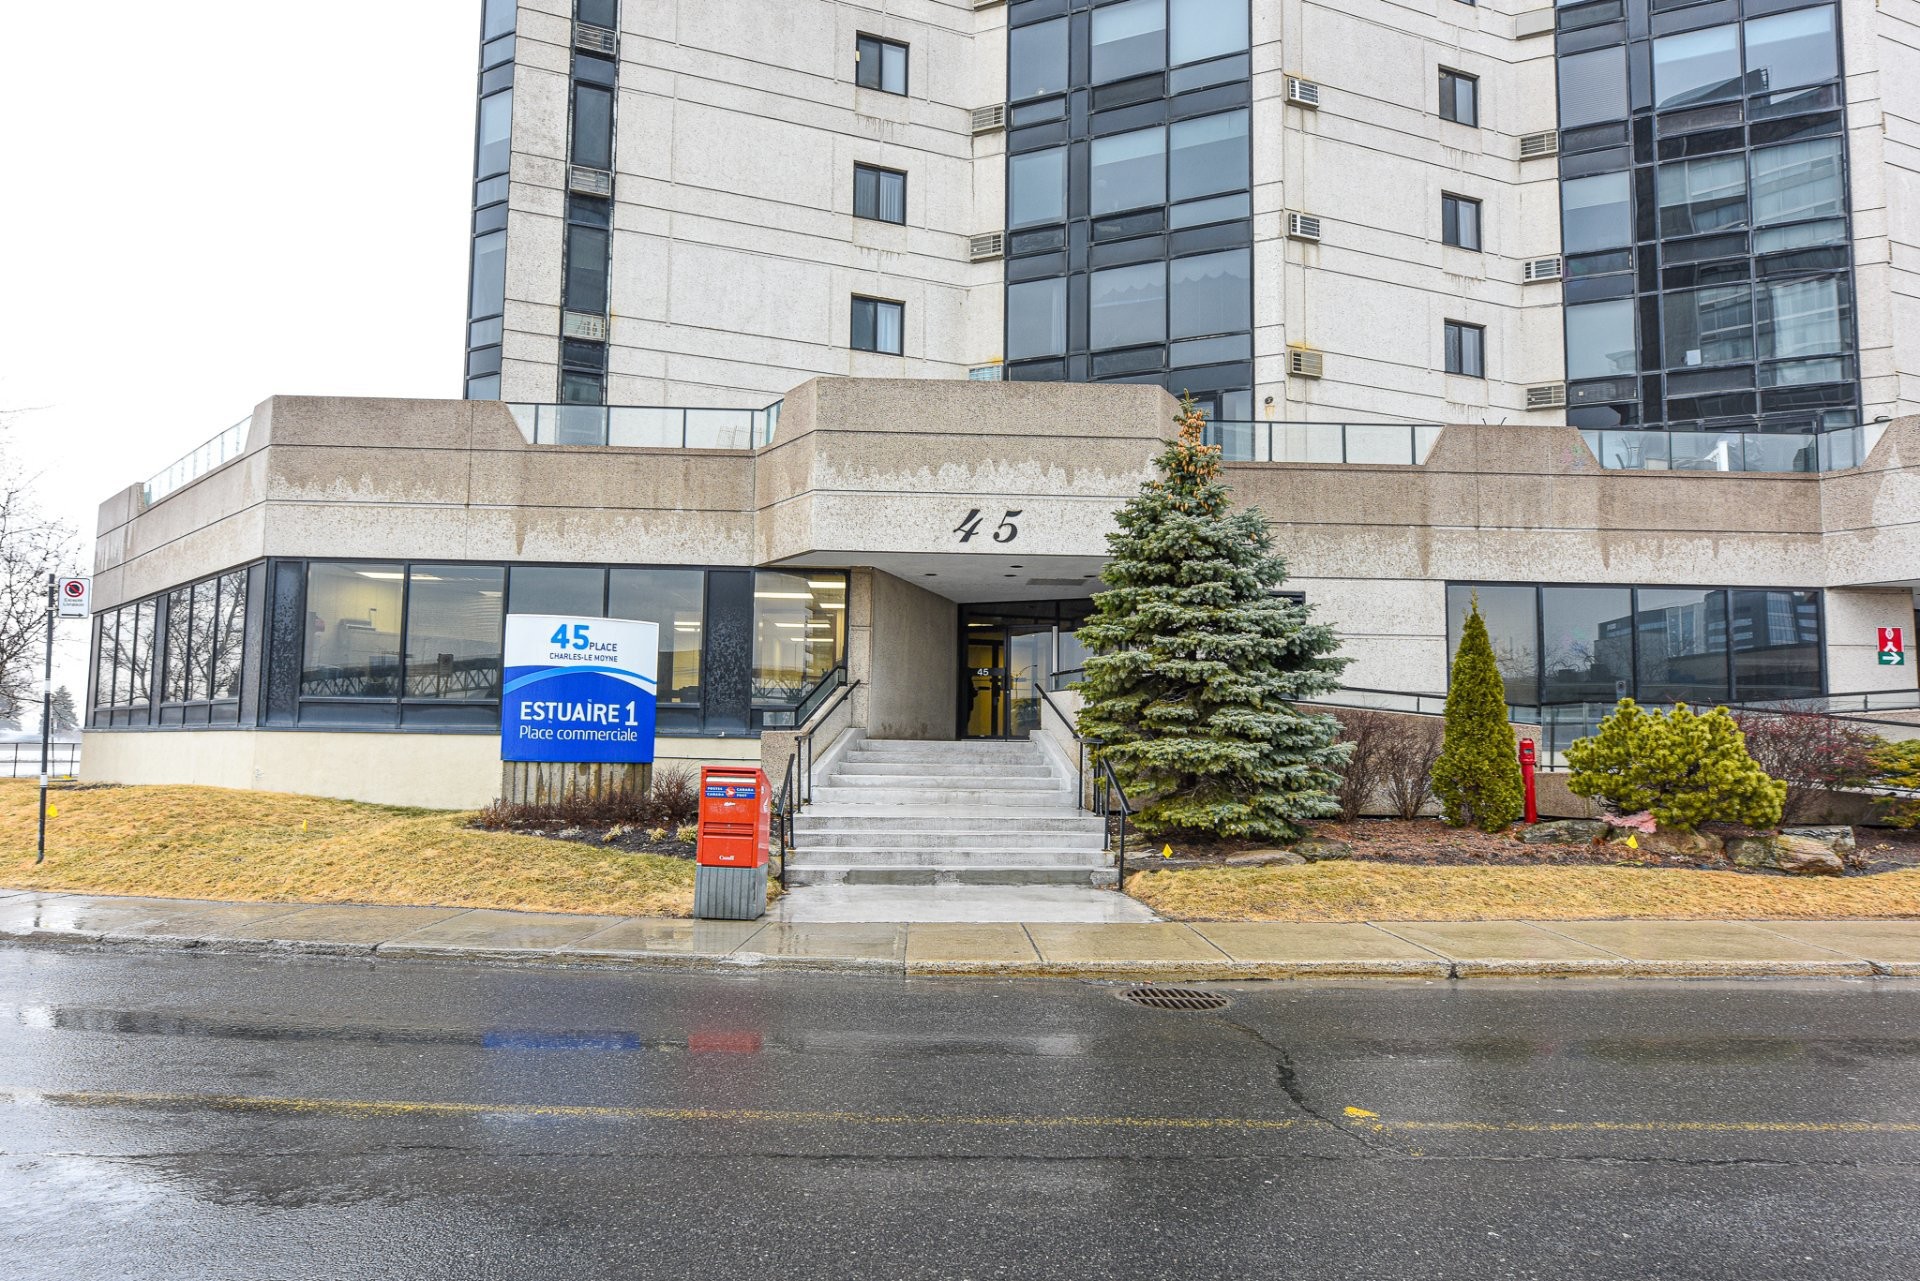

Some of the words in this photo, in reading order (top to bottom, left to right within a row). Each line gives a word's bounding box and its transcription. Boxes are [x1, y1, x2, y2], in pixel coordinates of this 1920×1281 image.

[952, 508, 1023, 543] 45
[550, 623, 590, 650] 45
[589, 642, 618, 652] PLACE
[593, 654, 618, 663] MOYNE
[977, 668, 989, 676] 45
[624, 700, 639, 726] 1
[519, 725, 554, 740] Place
[556, 728, 638, 742] commerciale
